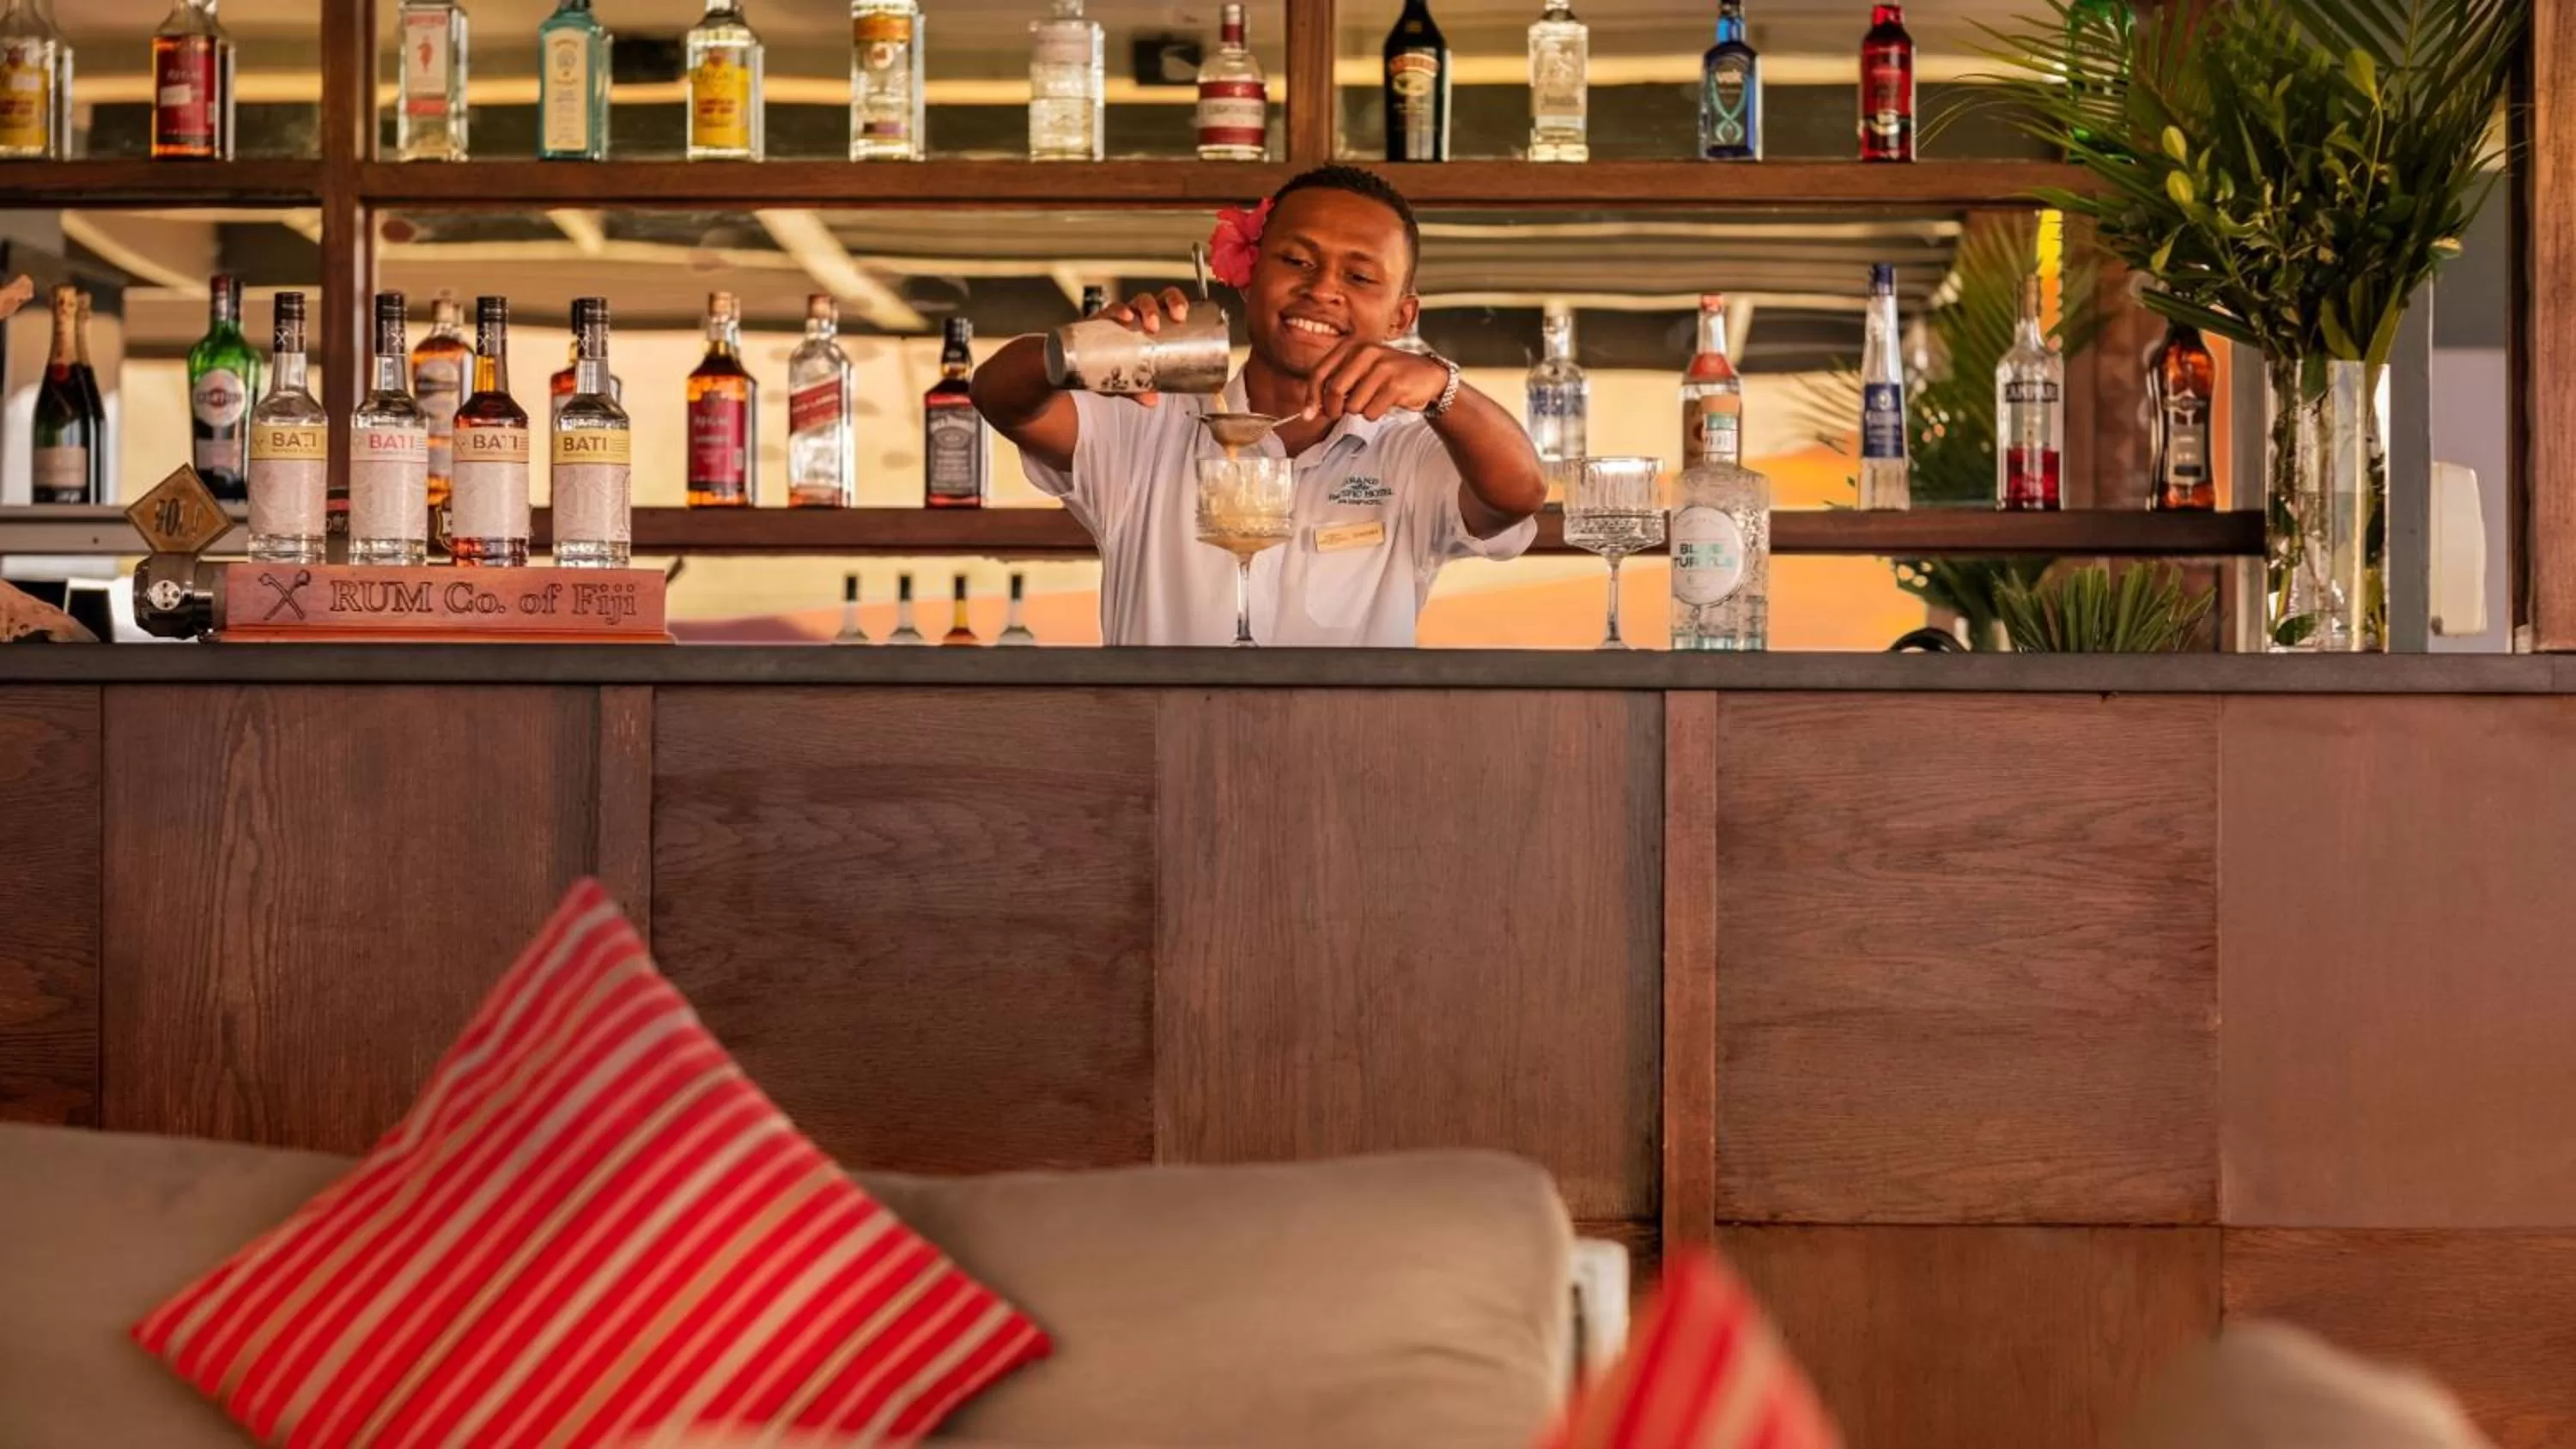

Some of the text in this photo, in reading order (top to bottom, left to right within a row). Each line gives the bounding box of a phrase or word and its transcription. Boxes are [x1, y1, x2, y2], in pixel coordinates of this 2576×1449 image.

[271, 432, 317, 447] BATI
[369, 433, 415, 449] BATI
[473, 433, 519, 450] BATI
[562, 436, 607, 452] BATI
[1679, 543, 1723, 555] BLE
[330, 580, 638, 625] RUM Co. of Fiji
